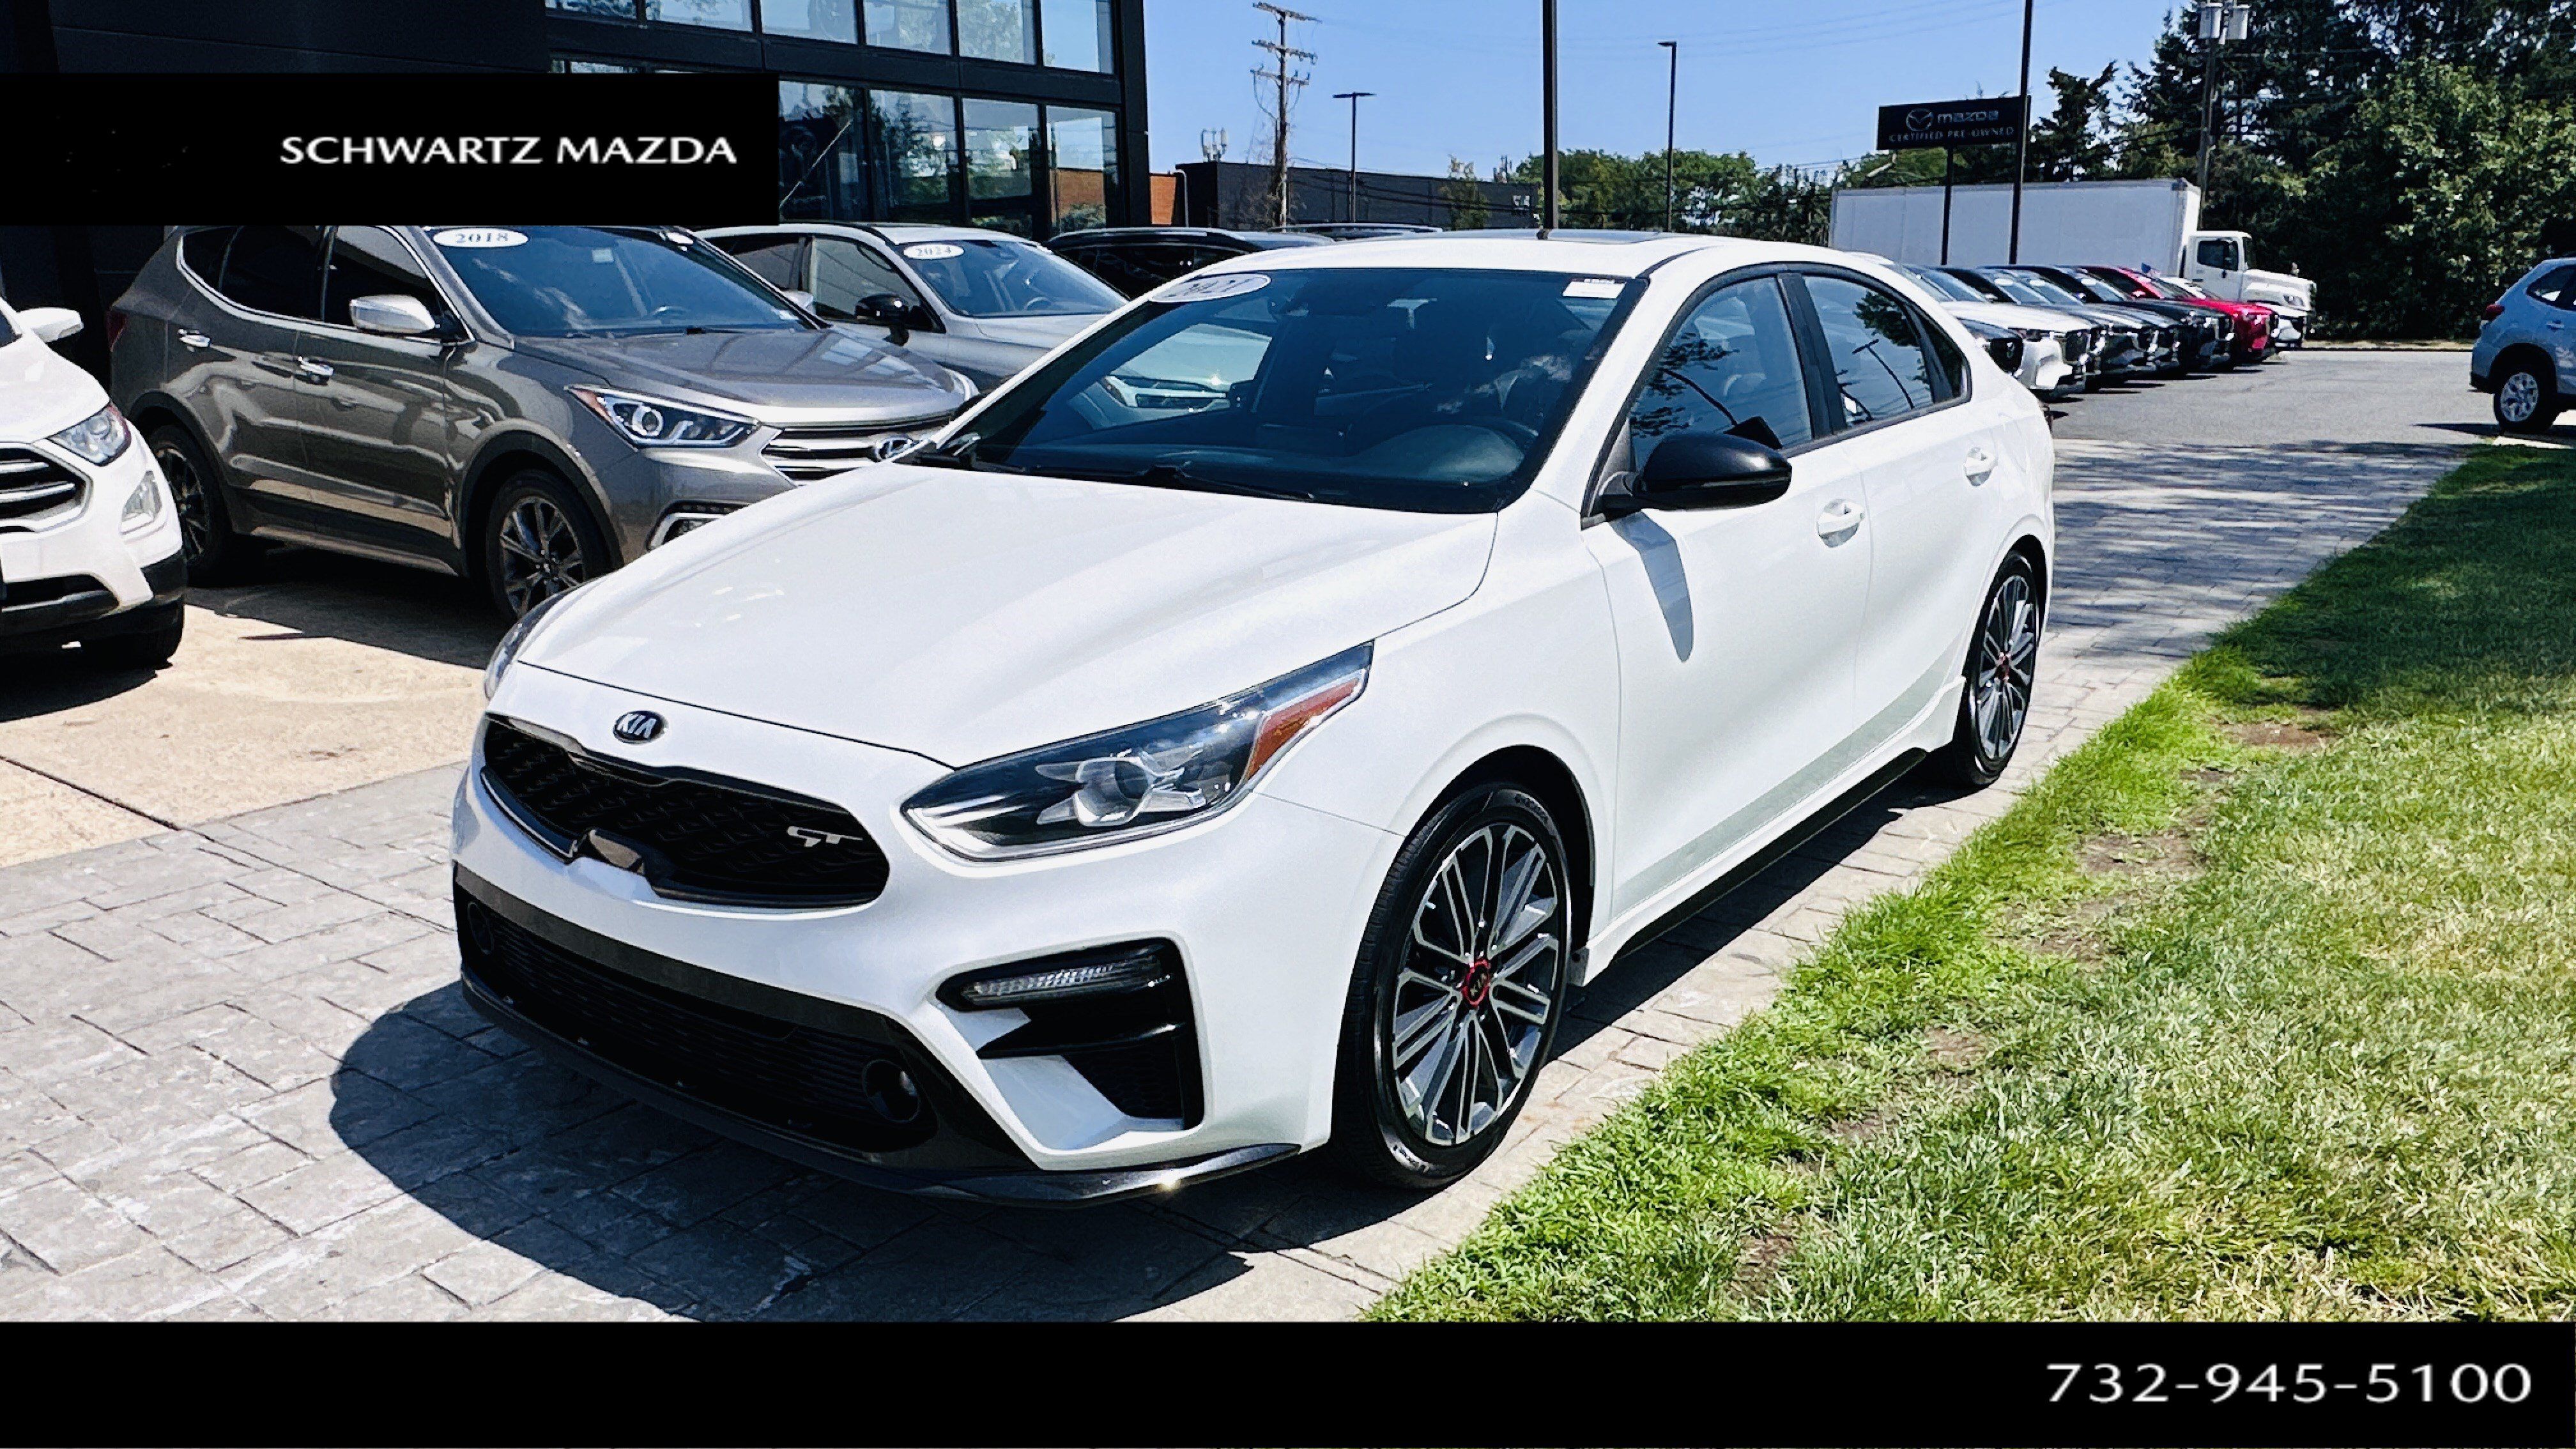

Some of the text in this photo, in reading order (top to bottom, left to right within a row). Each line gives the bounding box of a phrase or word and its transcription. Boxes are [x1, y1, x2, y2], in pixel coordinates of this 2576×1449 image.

[1889, 126, 2015, 142] CERTIFIED PRE-OWNED
[455, 233, 509, 243] 2018
[616, 713, 657, 739] KIA
[786, 826, 863, 847] GT
